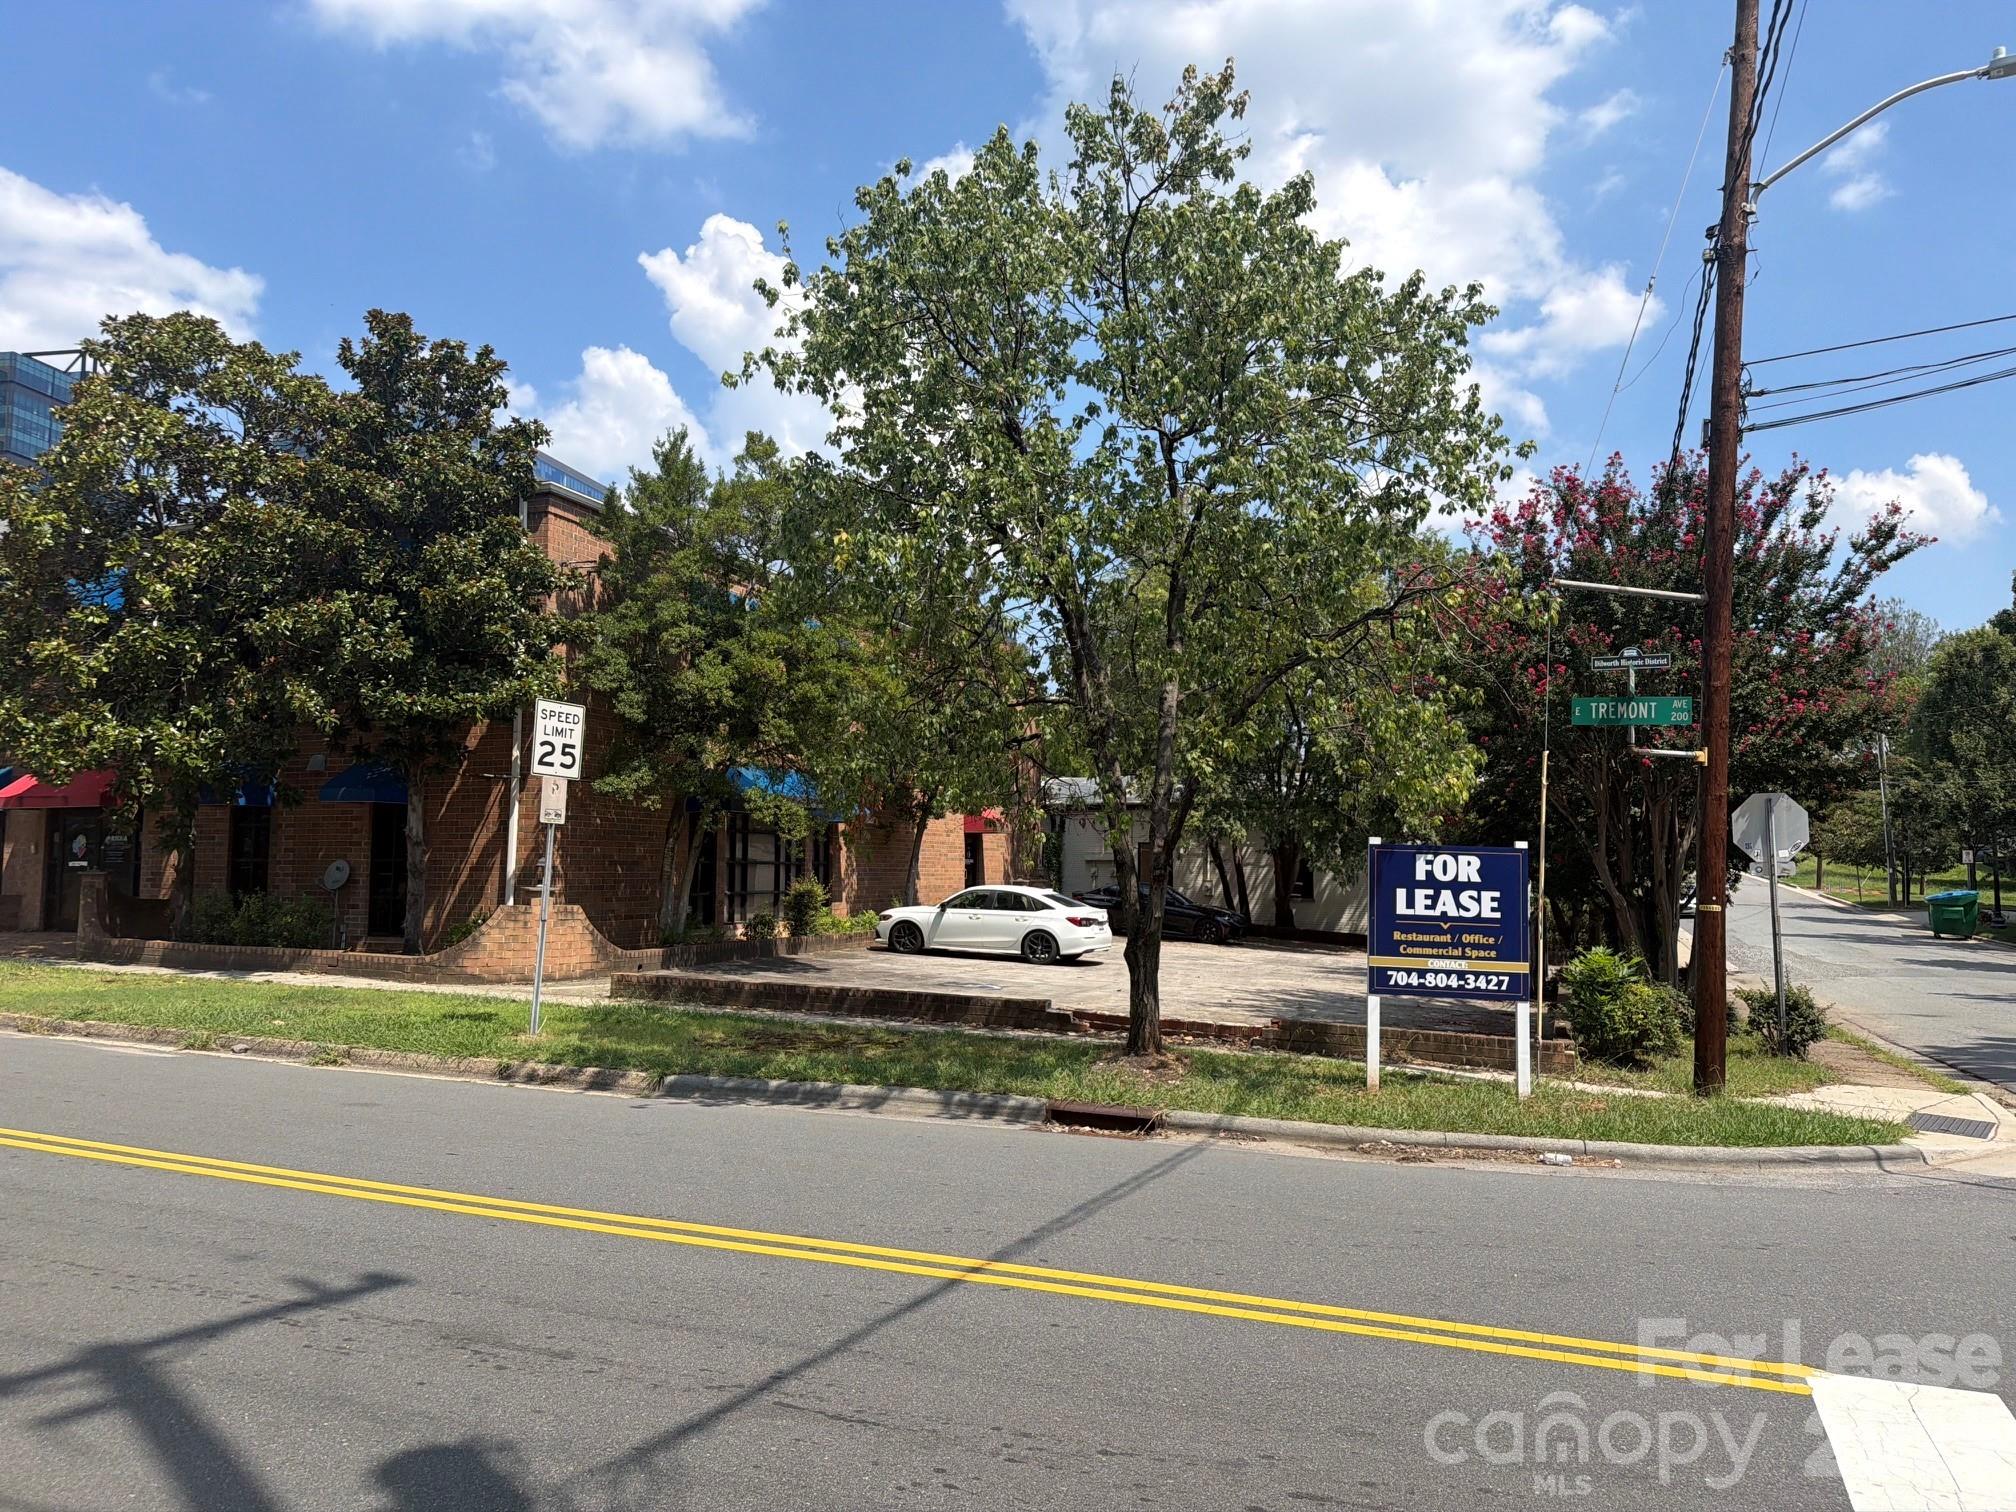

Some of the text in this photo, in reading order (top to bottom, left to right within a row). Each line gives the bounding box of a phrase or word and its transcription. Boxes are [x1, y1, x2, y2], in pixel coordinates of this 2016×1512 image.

[1645, 657, 1667, 665] District
[540, 708, 580, 725] SPEED
[1575, 700, 1687, 719] E TREMONT AVE
[1670, 712, 1688, 721] 200
[544, 724, 575, 739] LIMIT
[538, 740, 576, 769] 25
[1415, 853, 1482, 883] FOR
[1396, 888, 1501, 919] LEASE
[1393, 931, 1451, 943] Restaurant
[1454, 934, 1459, 943] /
[1461, 934, 1496, 945] Office
[1399, 945, 1497, 958] Commercial Space
[1427, 959, 1469, 969] CONTACT:
[1387, 971, 1510, 991] 704-804-3427
